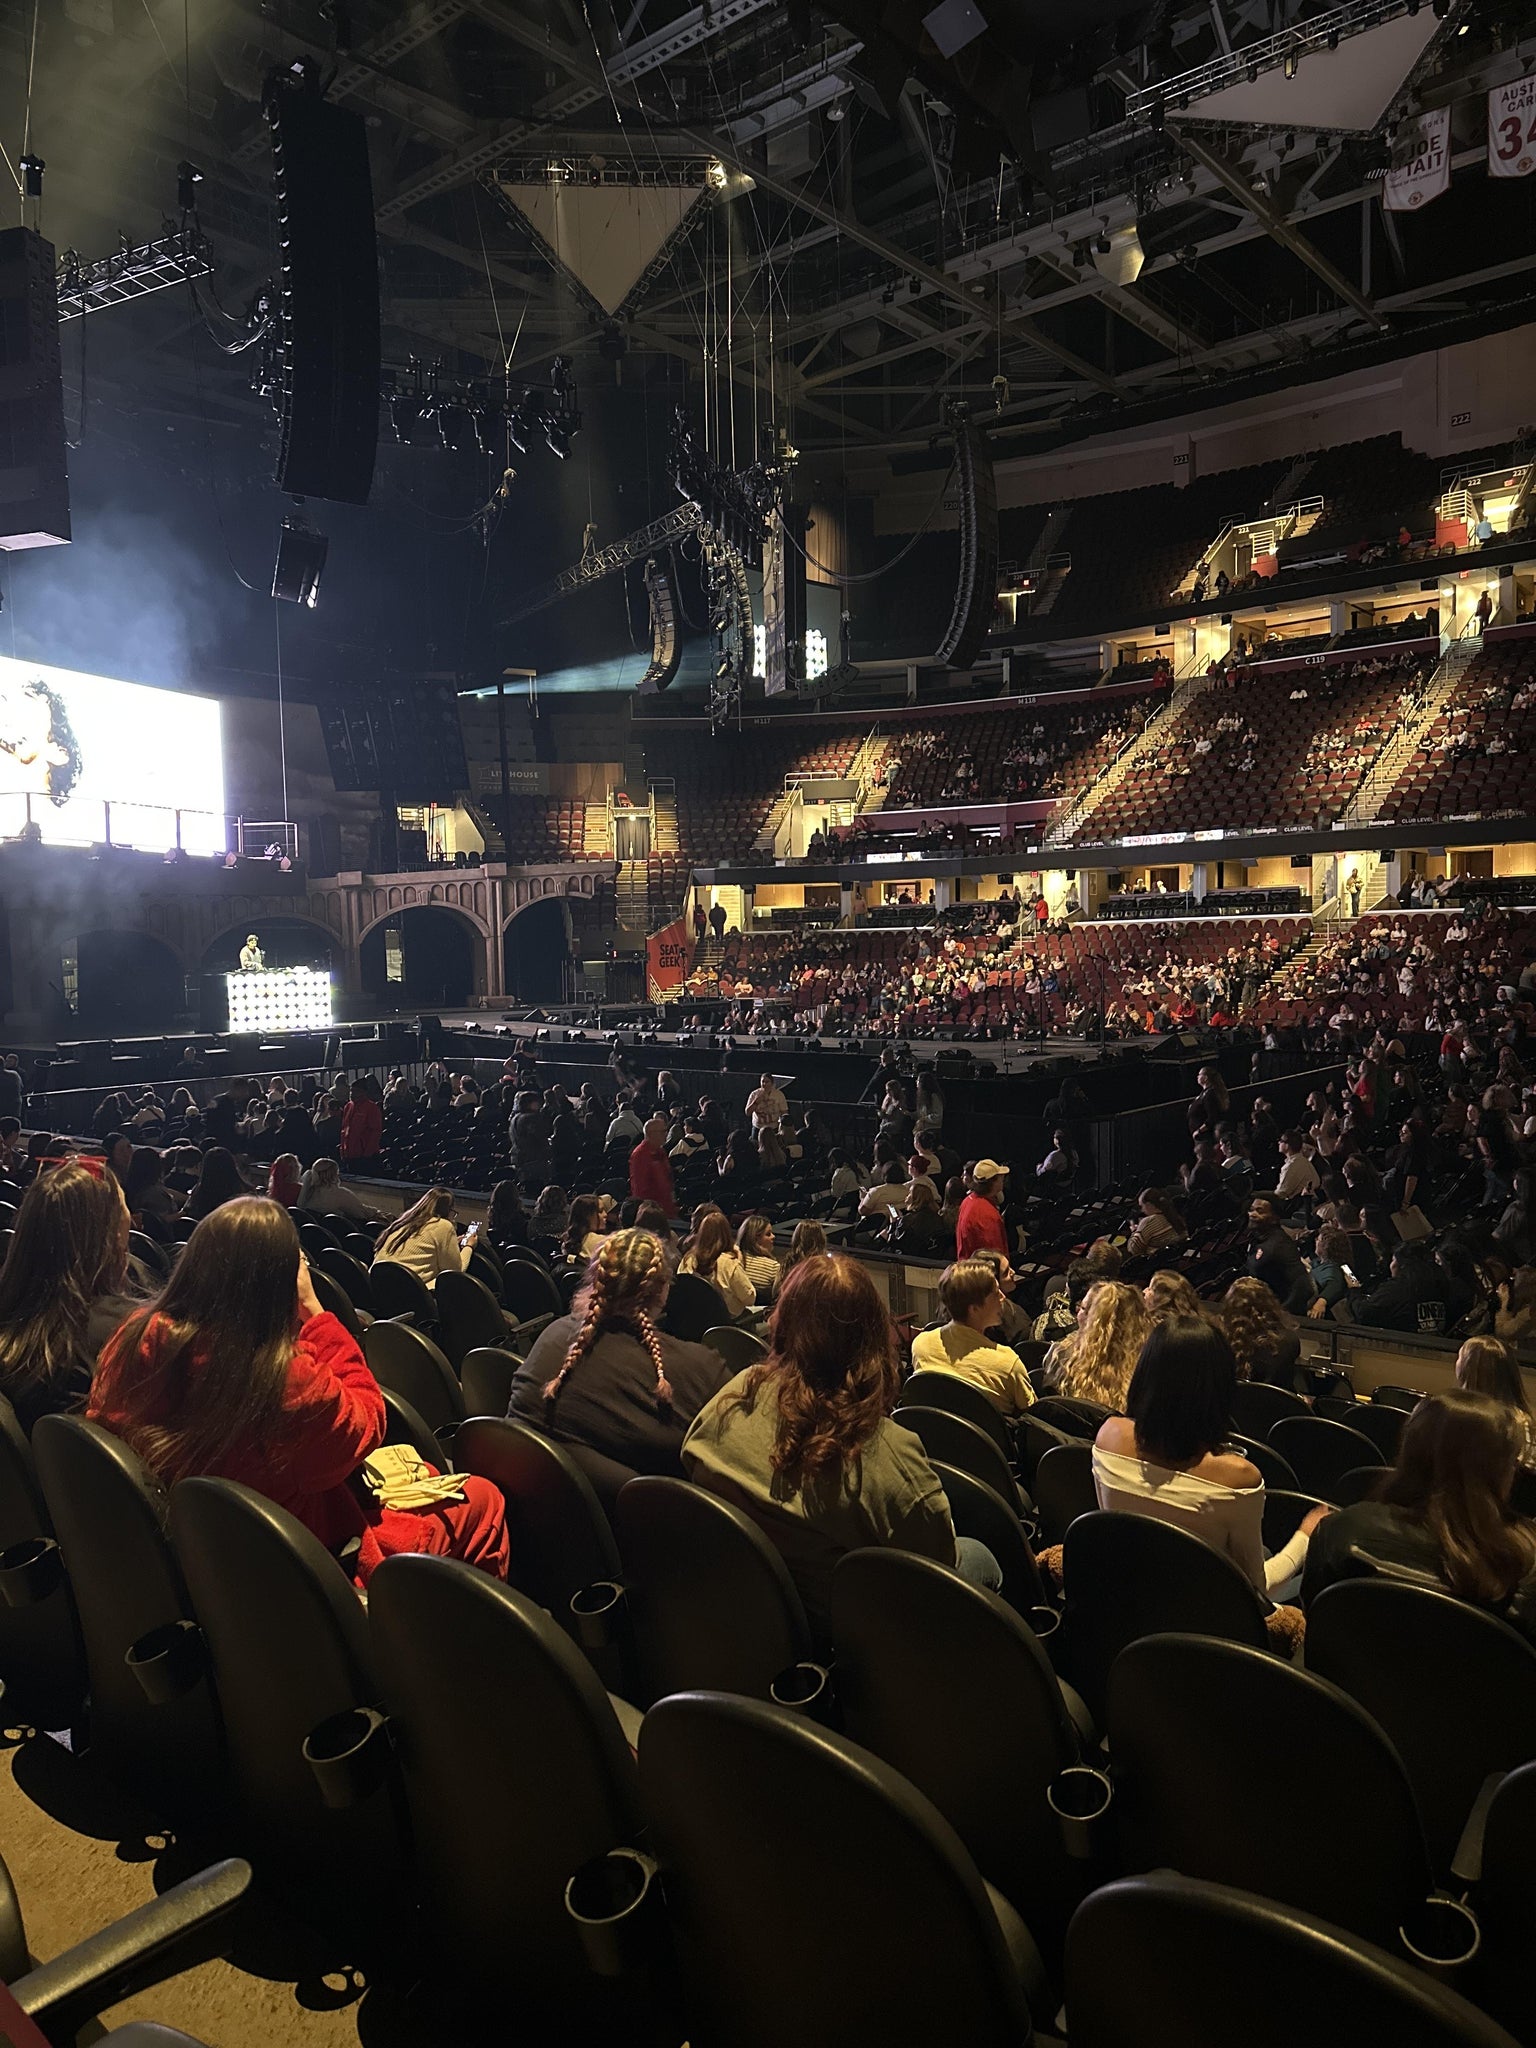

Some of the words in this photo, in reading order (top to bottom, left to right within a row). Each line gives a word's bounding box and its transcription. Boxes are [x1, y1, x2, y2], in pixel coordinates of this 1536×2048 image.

[1410, 135, 1441, 158] JOE
[1404, 151, 1443, 177] TAIT
[1452, 414, 1470, 425] 222
[1174, 456, 1188, 465] 221
[1512, 469, 1526, 477] 223
[1311, 656, 1325, 664] 119
